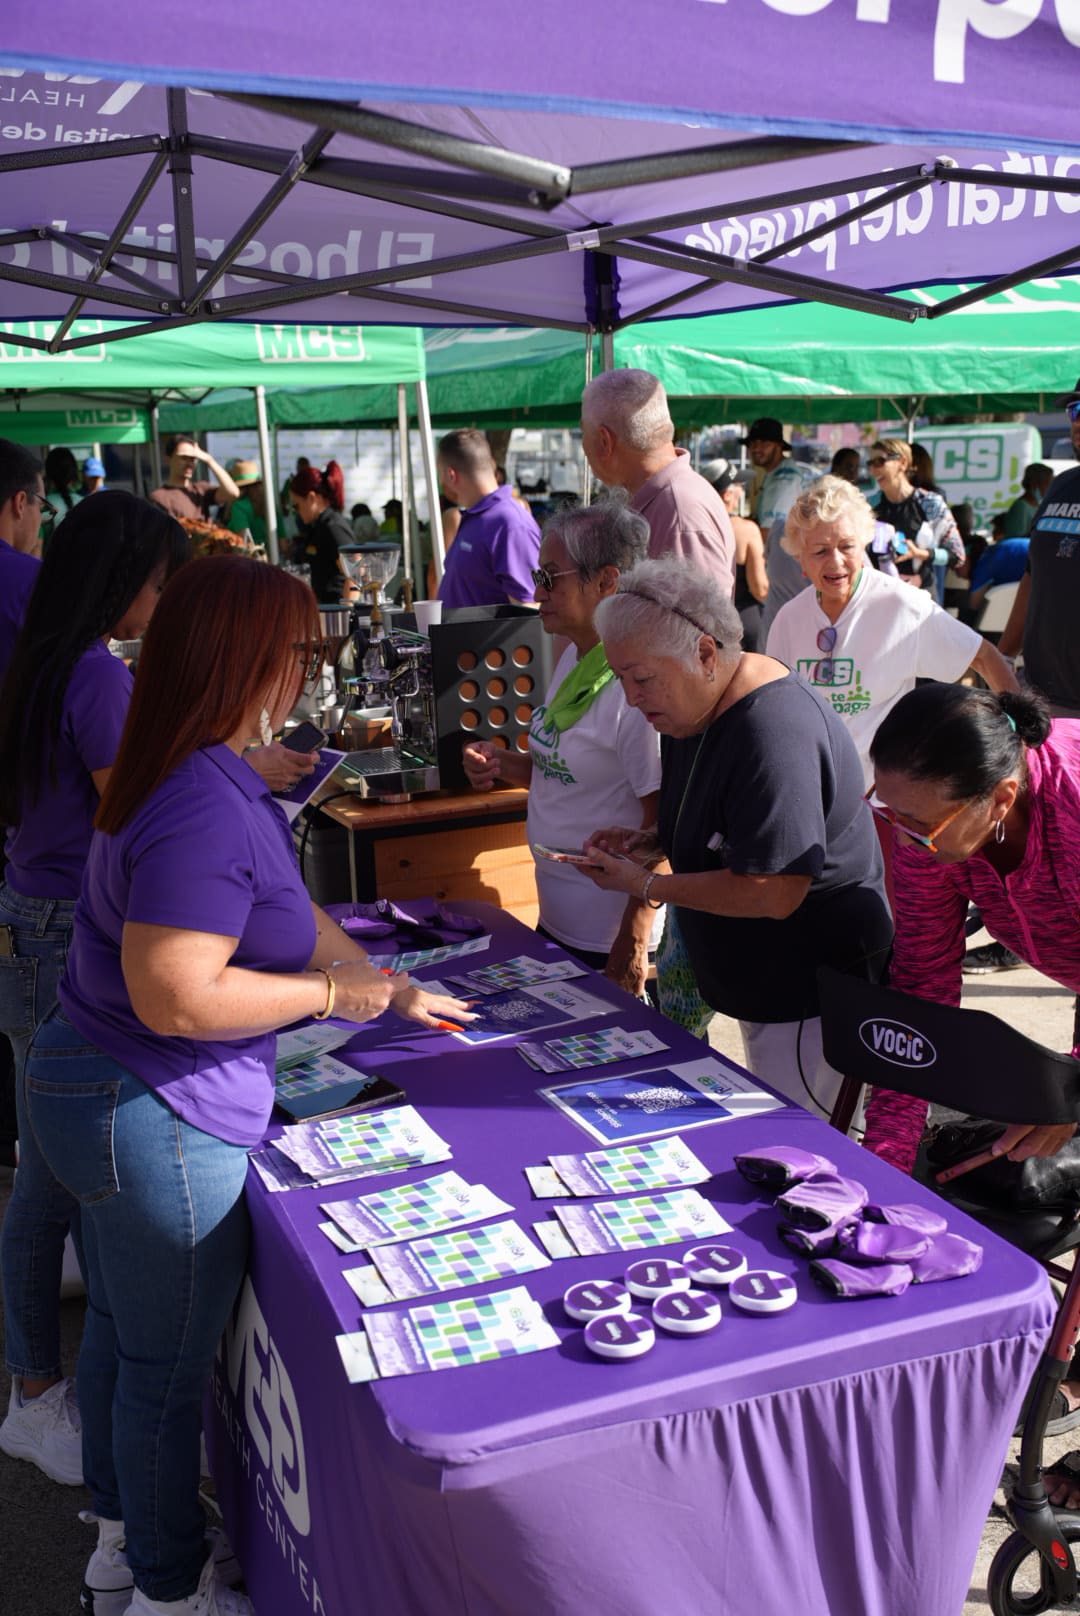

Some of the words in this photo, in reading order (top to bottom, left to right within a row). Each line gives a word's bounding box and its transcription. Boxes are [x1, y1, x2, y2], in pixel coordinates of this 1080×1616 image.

[255, 323, 365, 363] MCS
[1043, 503, 1080, 519] MAR
[831, 692, 845, 702] te
